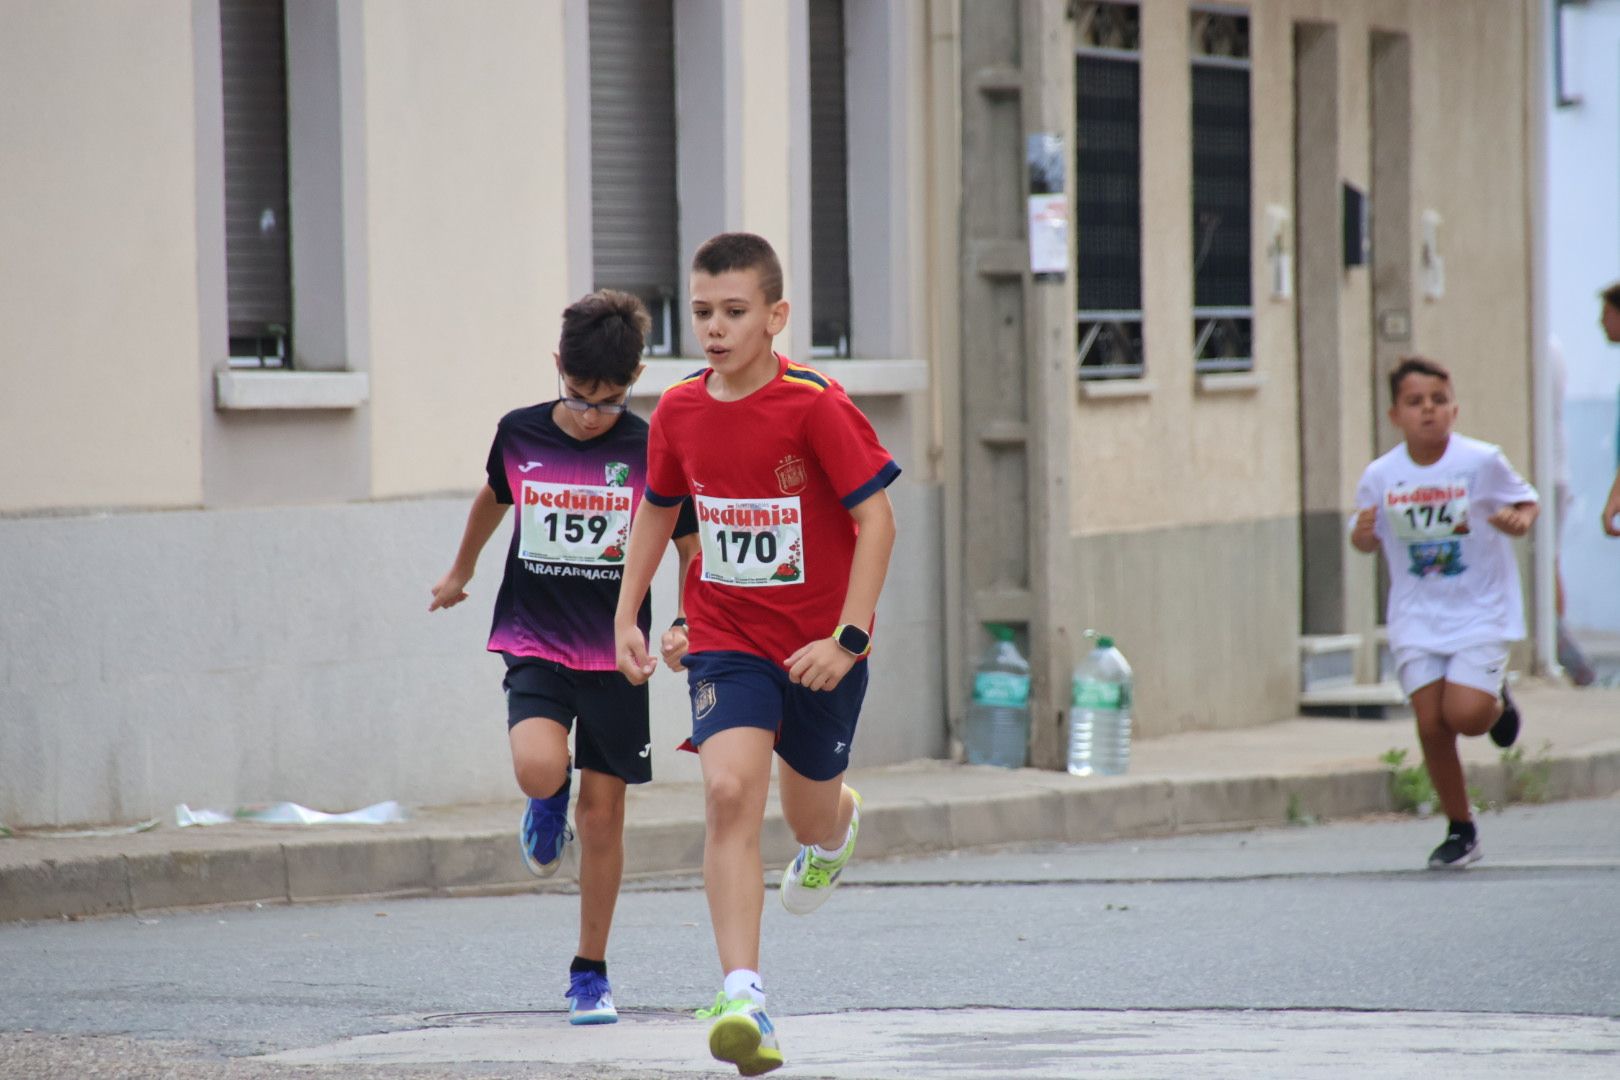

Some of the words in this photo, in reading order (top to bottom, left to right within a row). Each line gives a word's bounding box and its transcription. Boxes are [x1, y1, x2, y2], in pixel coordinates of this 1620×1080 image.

[524, 486, 630, 511] bedunia
[699, 501, 799, 527] bedunia
[1405, 505, 1453, 529] 174
[544, 512, 608, 544] 159
[716, 530, 777, 564] 170
